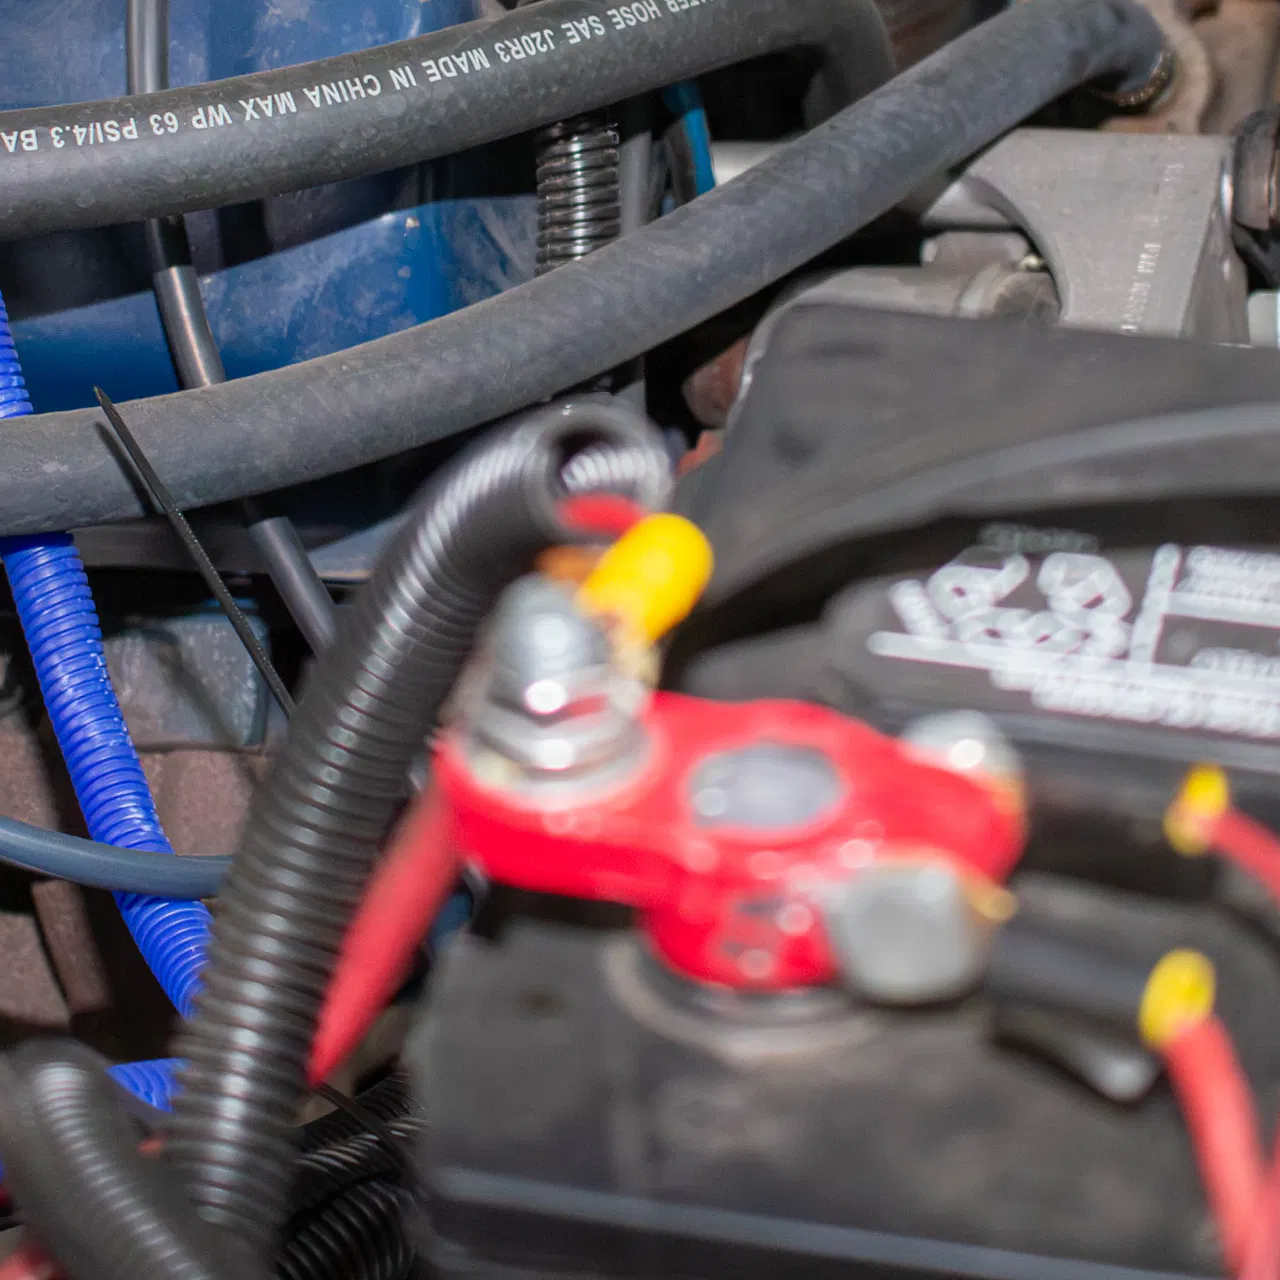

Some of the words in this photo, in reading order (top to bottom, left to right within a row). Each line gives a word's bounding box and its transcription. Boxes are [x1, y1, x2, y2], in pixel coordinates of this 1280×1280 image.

[494, 28, 556, 63] J20R3
[560, 15, 607, 46] SAE
[388, 64, 417, 92] IN
[422, 46, 491, 84] MADE
[240, 91, 298, 121] MAX
[302, 73, 382, 109] CHINA
[148, 110, 180, 135] 63
[191, 103, 233, 131] WP
[51, 118, 139, 149] PSI/4.3
